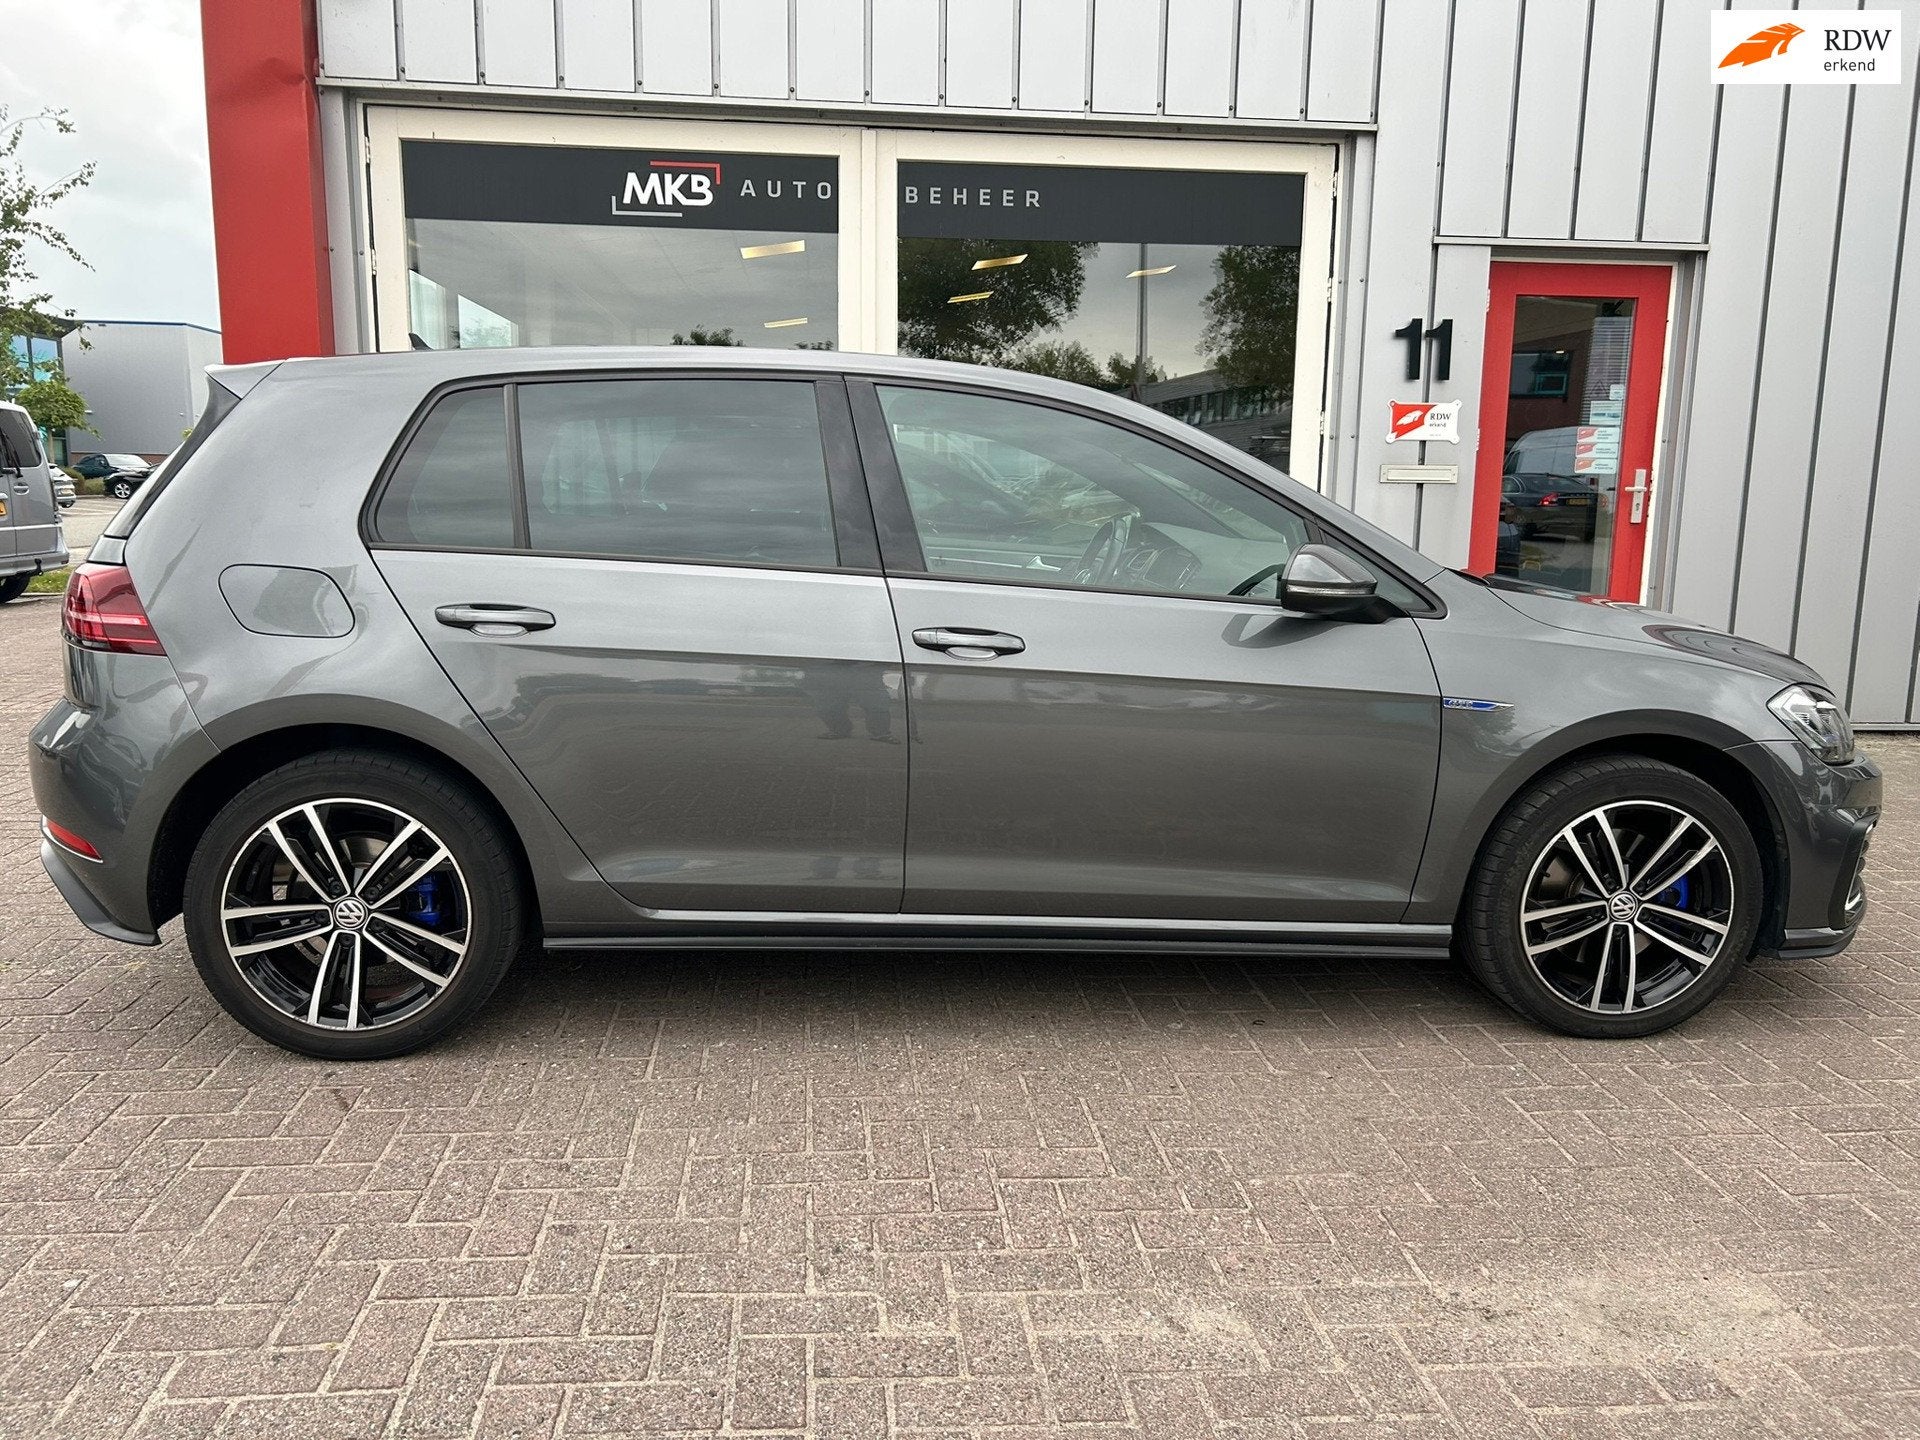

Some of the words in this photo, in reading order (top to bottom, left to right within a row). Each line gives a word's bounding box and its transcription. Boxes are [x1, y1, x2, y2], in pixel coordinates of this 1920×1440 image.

[622, 171, 714, 207] MKB
[740, 179, 833, 201] AUTO
[905, 186, 1041, 208] BEHEER
[1394, 318, 1454, 381] 11
[1429, 412, 1452, 421] RDW
